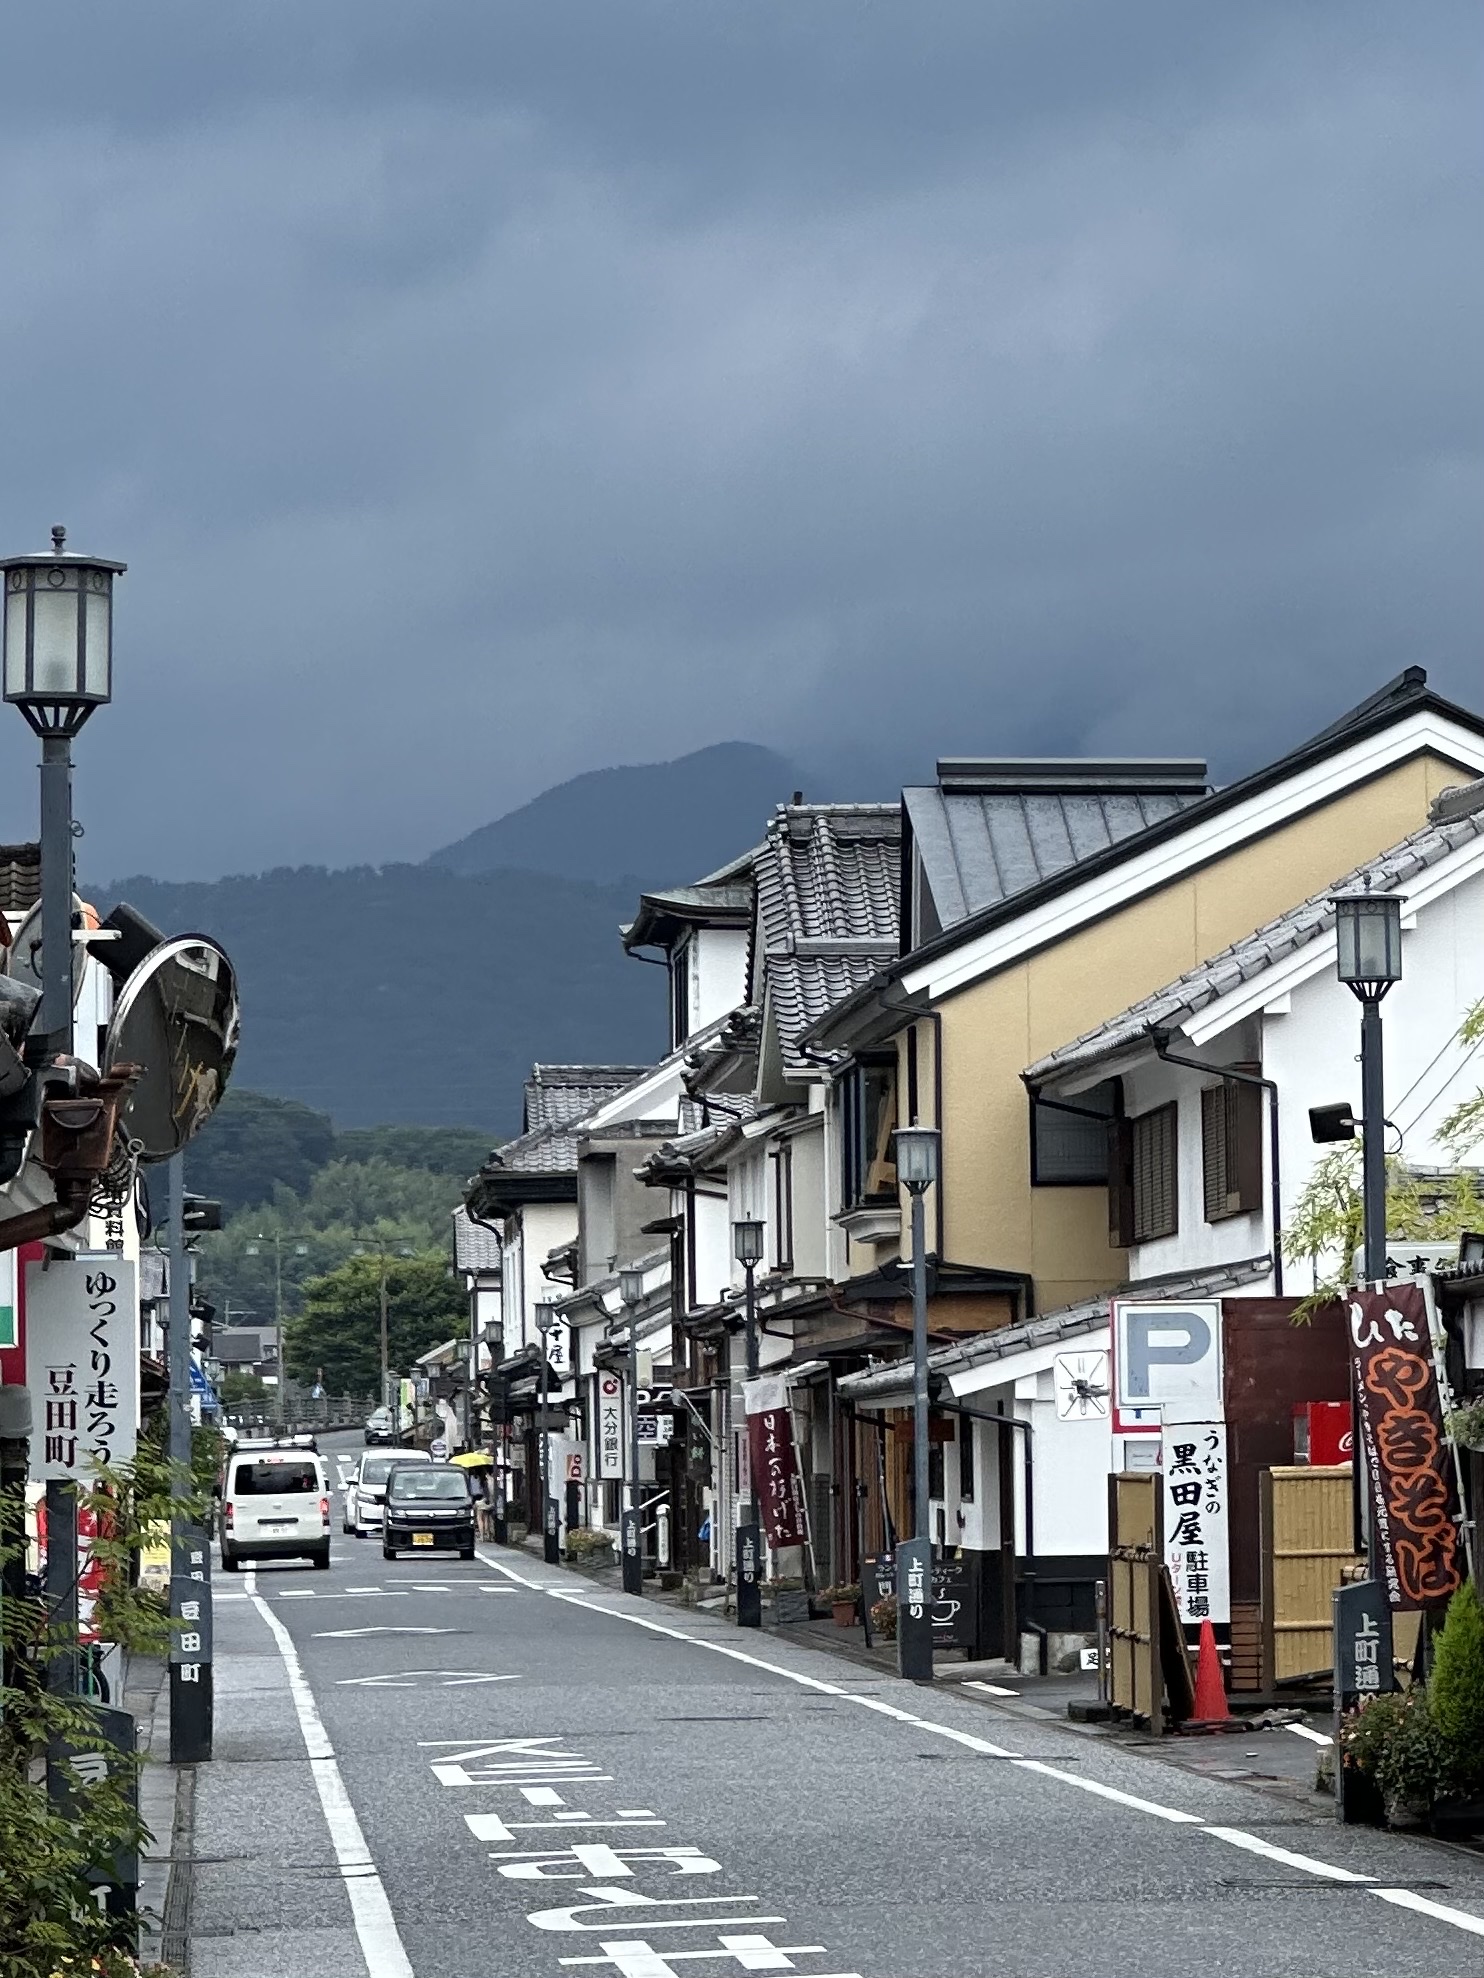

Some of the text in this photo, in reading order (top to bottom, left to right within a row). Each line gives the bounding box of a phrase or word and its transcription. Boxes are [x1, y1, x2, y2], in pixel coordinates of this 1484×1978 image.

[84, 1271, 119, 1466] ゆっくり走ろう
[1126, 1312, 1212, 1398] P
[1349, 1302, 1419, 1348] ひた
[44, 1363, 80, 1468] 豆田町
[603, 1406, 618, 1467] 大分銀行
[763, 1414, 792, 1539] 日本一の杉げた
[1169, 1443, 1204, 1546] 黒田屋
[1202, 1430, 1222, 1515] うなぎの
[1366, 1347, 1461, 1601] やきそば
[1186, 1550, 1210, 1618] 駐車場
